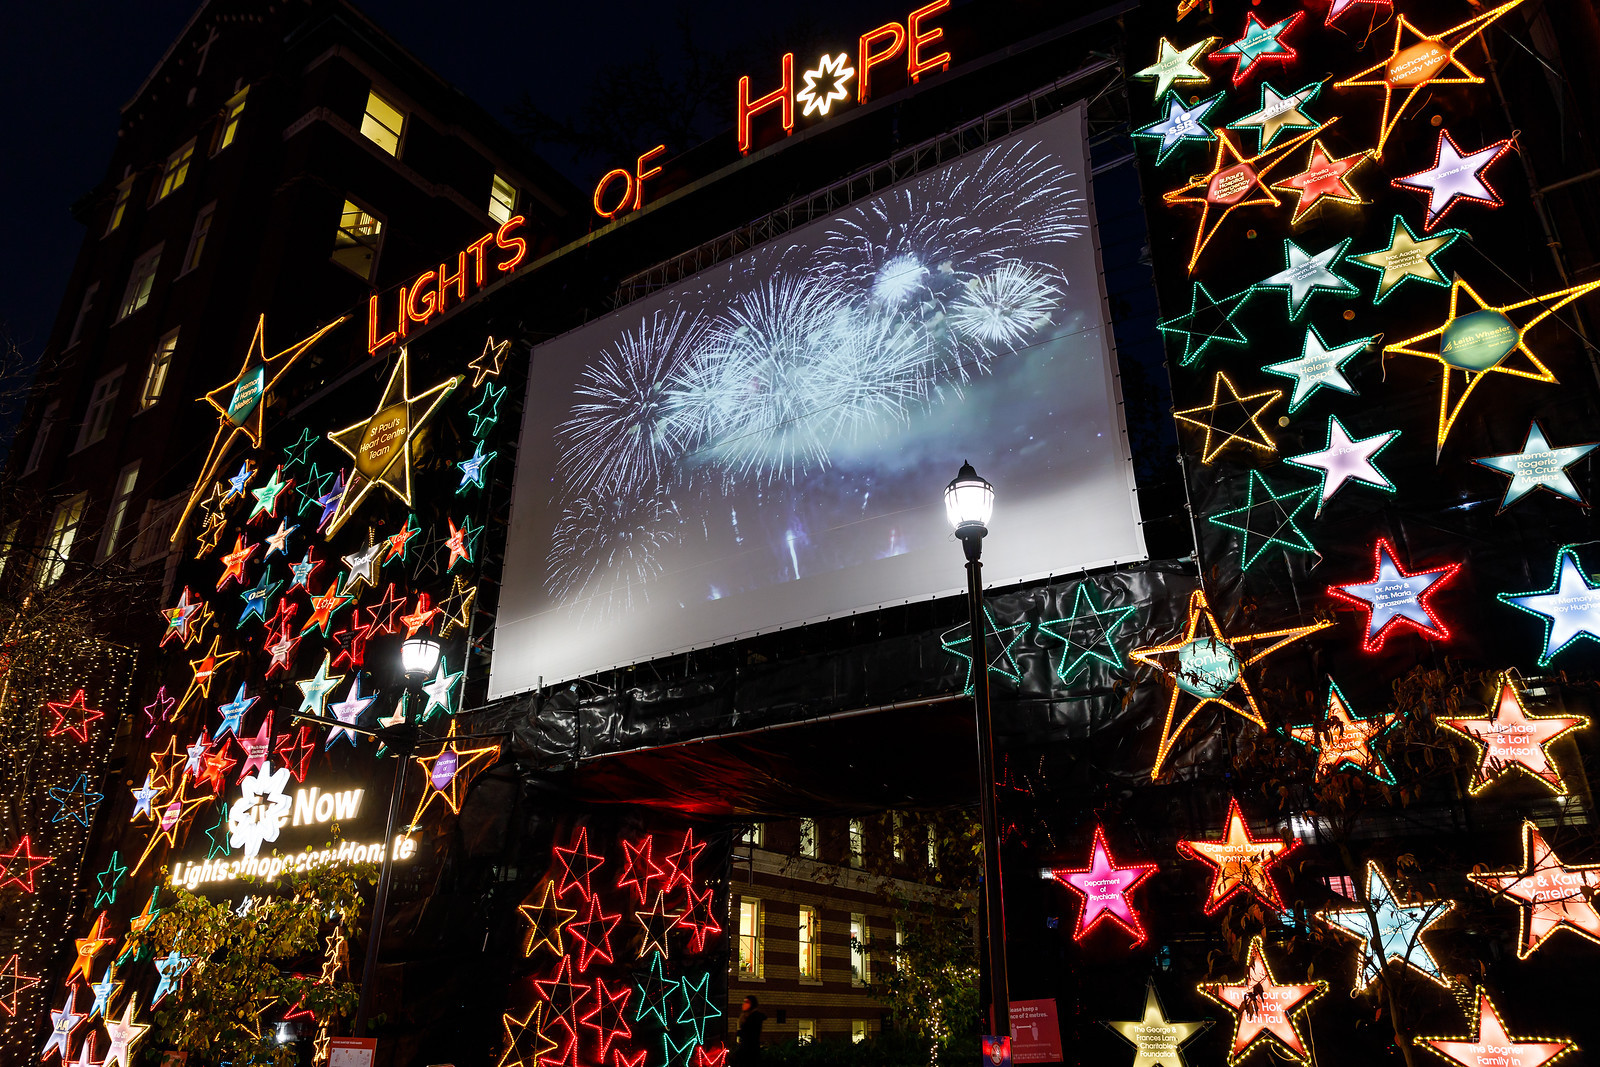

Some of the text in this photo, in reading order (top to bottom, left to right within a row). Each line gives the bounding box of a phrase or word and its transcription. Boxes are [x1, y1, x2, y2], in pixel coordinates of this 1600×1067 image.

[1390, 48, 1440, 75] Michael &
[1389, 53, 1448, 83] Wendy Wan
[1168, 119, 1193, 135] SSR
[1310, 168, 1329, 178] Sheila
[1437, 167, 1460, 180] James
[1213, 179, 1251, 196] Emergency
[1219, 176, 1245, 189] Hospital
[368, 215, 526, 355] LIGHTS
[594, 145, 665, 217] OF
[1387, 261, 1412, 271] Connor
[1453, 325, 1511, 346] Leith Wheeler
[1300, 360, 1335, 374] Helene
[378, 417, 401, 434] Paul's
[360, 427, 407, 453] Heart Centre
[369, 445, 390, 460] Team
[1514, 450, 1558, 461] memory
[1517, 458, 1558, 469] Rogerio
[1518, 465, 1559, 476] da Cruz
[1521, 473, 1560, 484] Martins
[1384, 584, 1403, 592] Andy
[1487, 724, 1537, 733] Michael
[1496, 735, 1530, 744] & Lori
[1490, 746, 1539, 756] Berkson
[293, 787, 363, 826] Now
[1225, 842, 1244, 853] and
[1084, 878, 1120, 887] Department
[1536, 875, 1550, 888] &
[1089, 893, 1120, 902] Psychiatry
[1230, 990, 1240, 999] In
[1281, 989, 1292, 999] of
[1264, 1013, 1283, 1023] Tau
[1146, 1026, 1171, 1035] George
[1139, 1042, 1174, 1050] Charitable
[1468, 1043, 1524, 1056] The Bogner
[1140, 1050, 1176, 1058] Foundation
[1477, 1056, 1521, 1067] Family In
